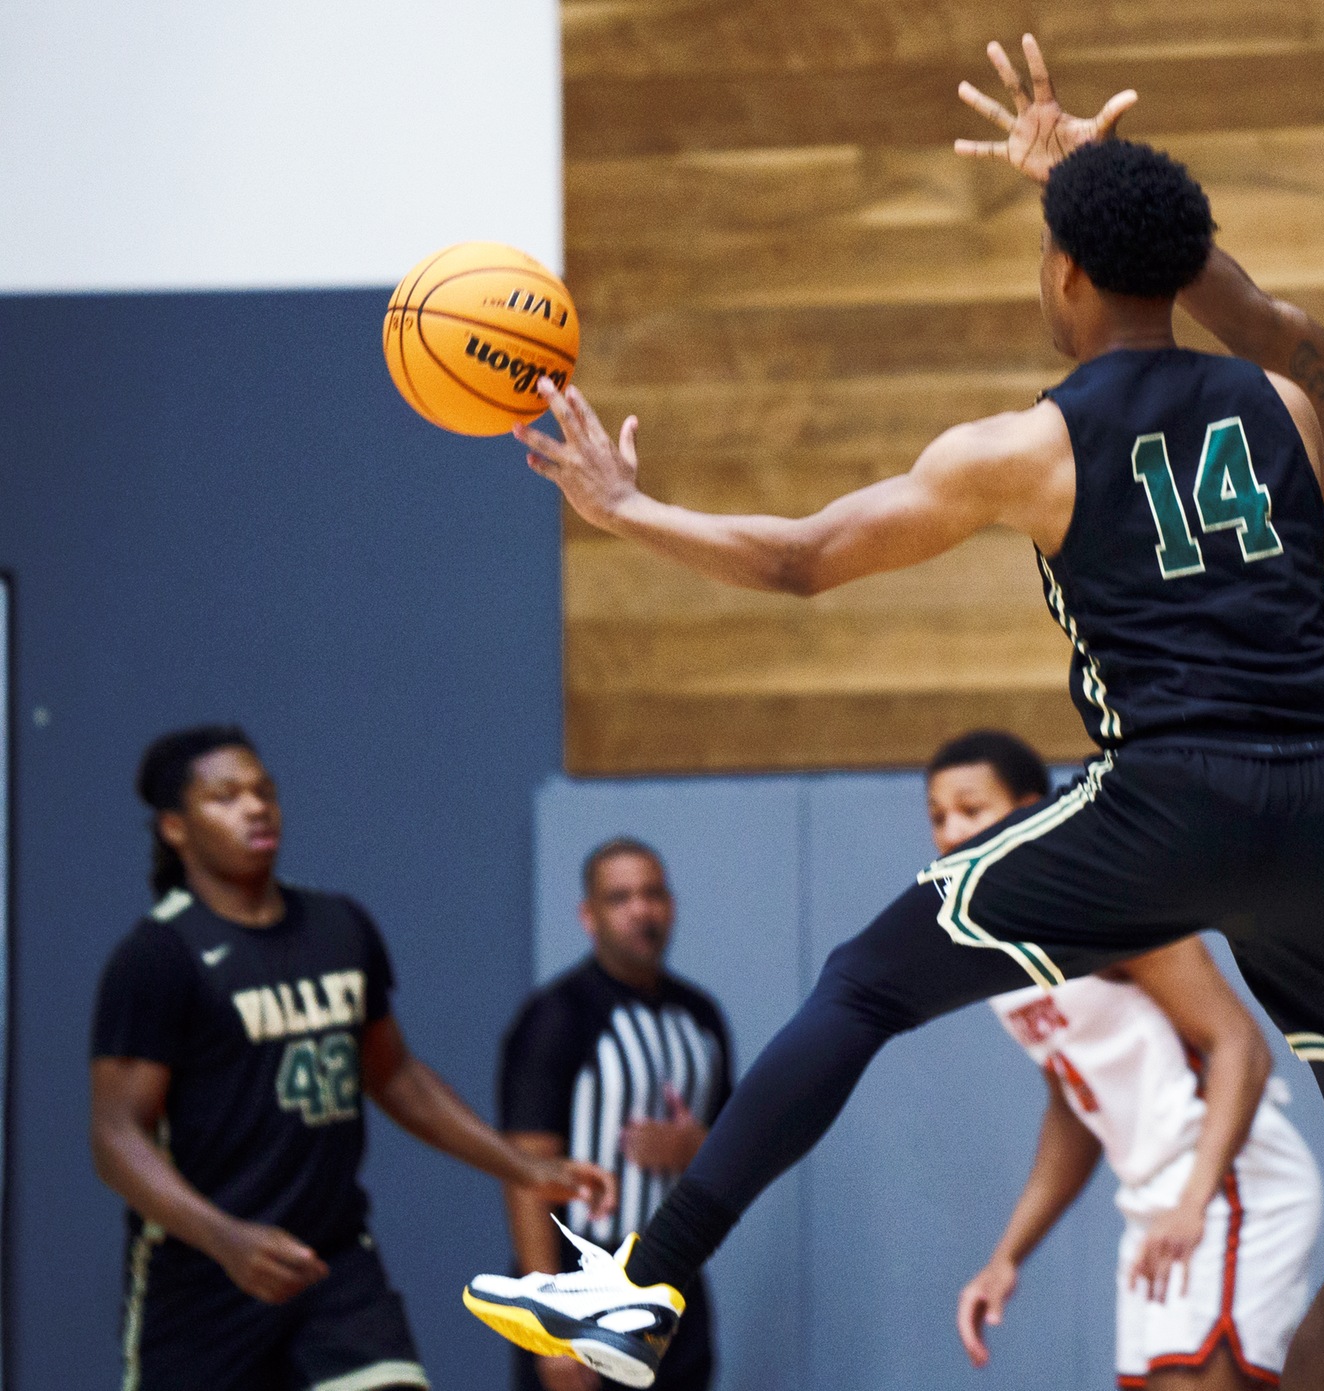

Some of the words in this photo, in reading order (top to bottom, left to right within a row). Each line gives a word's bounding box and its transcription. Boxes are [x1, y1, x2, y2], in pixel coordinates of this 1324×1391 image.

[1131, 416, 1285, 580] 14
[233, 970, 366, 1043] VALLEY
[275, 1033, 361, 1127] 42
